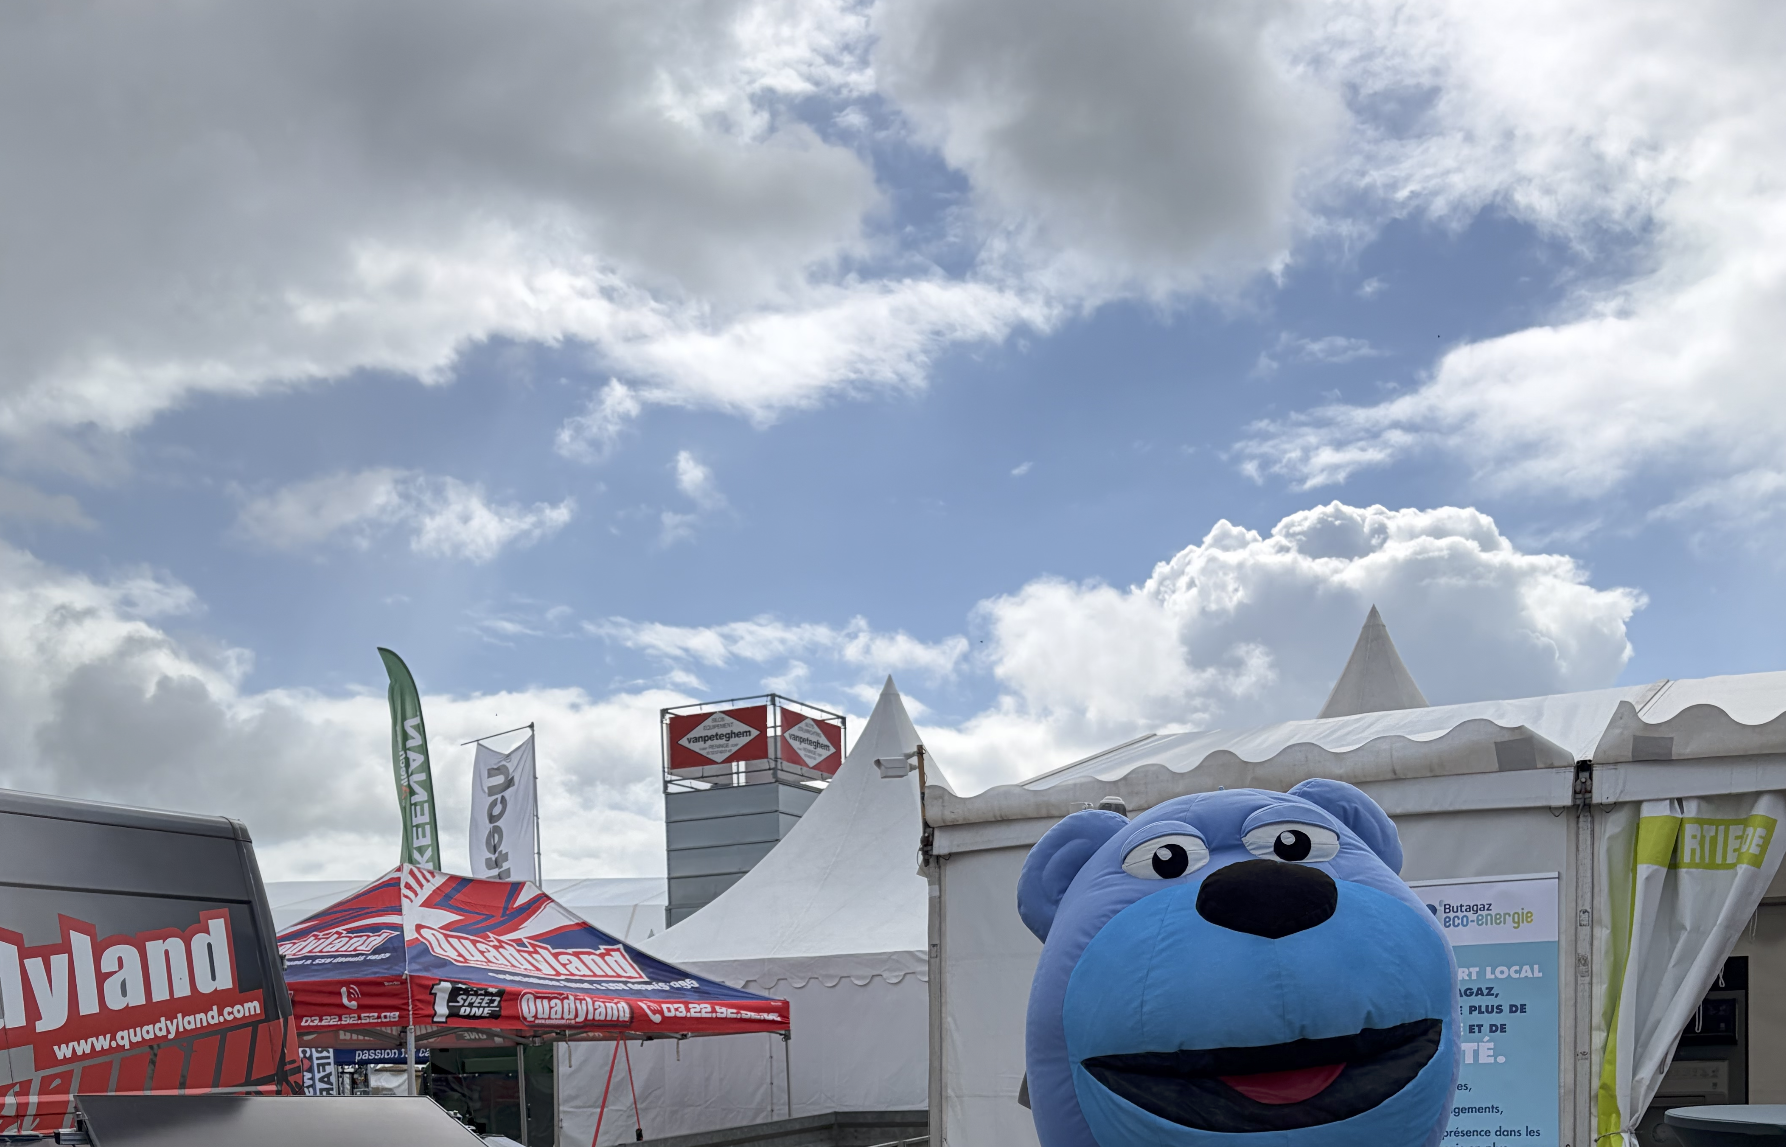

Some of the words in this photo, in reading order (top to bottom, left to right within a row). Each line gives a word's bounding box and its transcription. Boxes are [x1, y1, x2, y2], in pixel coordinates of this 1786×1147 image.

[687, 730, 751, 745] vanpeteghem
[788, 732, 830, 751] vanpeteghem
[1443, 903, 1493, 914] Butagaz
[1443, 908, 1534, 930] eco-energie
[420, 926, 640, 978] Quadyland
[1486, 965, 1543, 979] LOCAL
[431, 981, 452, 1021] 1
[521, 991, 632, 1022] Quadyland
[459, 1006, 499, 1017] ONE
[1468, 1004, 1504, 1015] PLUS
[1509, 1004, 1527, 1014] DE
[53, 999, 261, 1060] www.quadyland.com
[1468, 1024, 1484, 1034] ET
[1489, 1024, 1507, 1033] DE
[1461, 1036, 1506, 1064] TÉ.
[1451, 1104, 1504, 1117] gements,
[1494, 1125, 1522, 1137] dans
[1525, 1125, 1541, 1137] les
